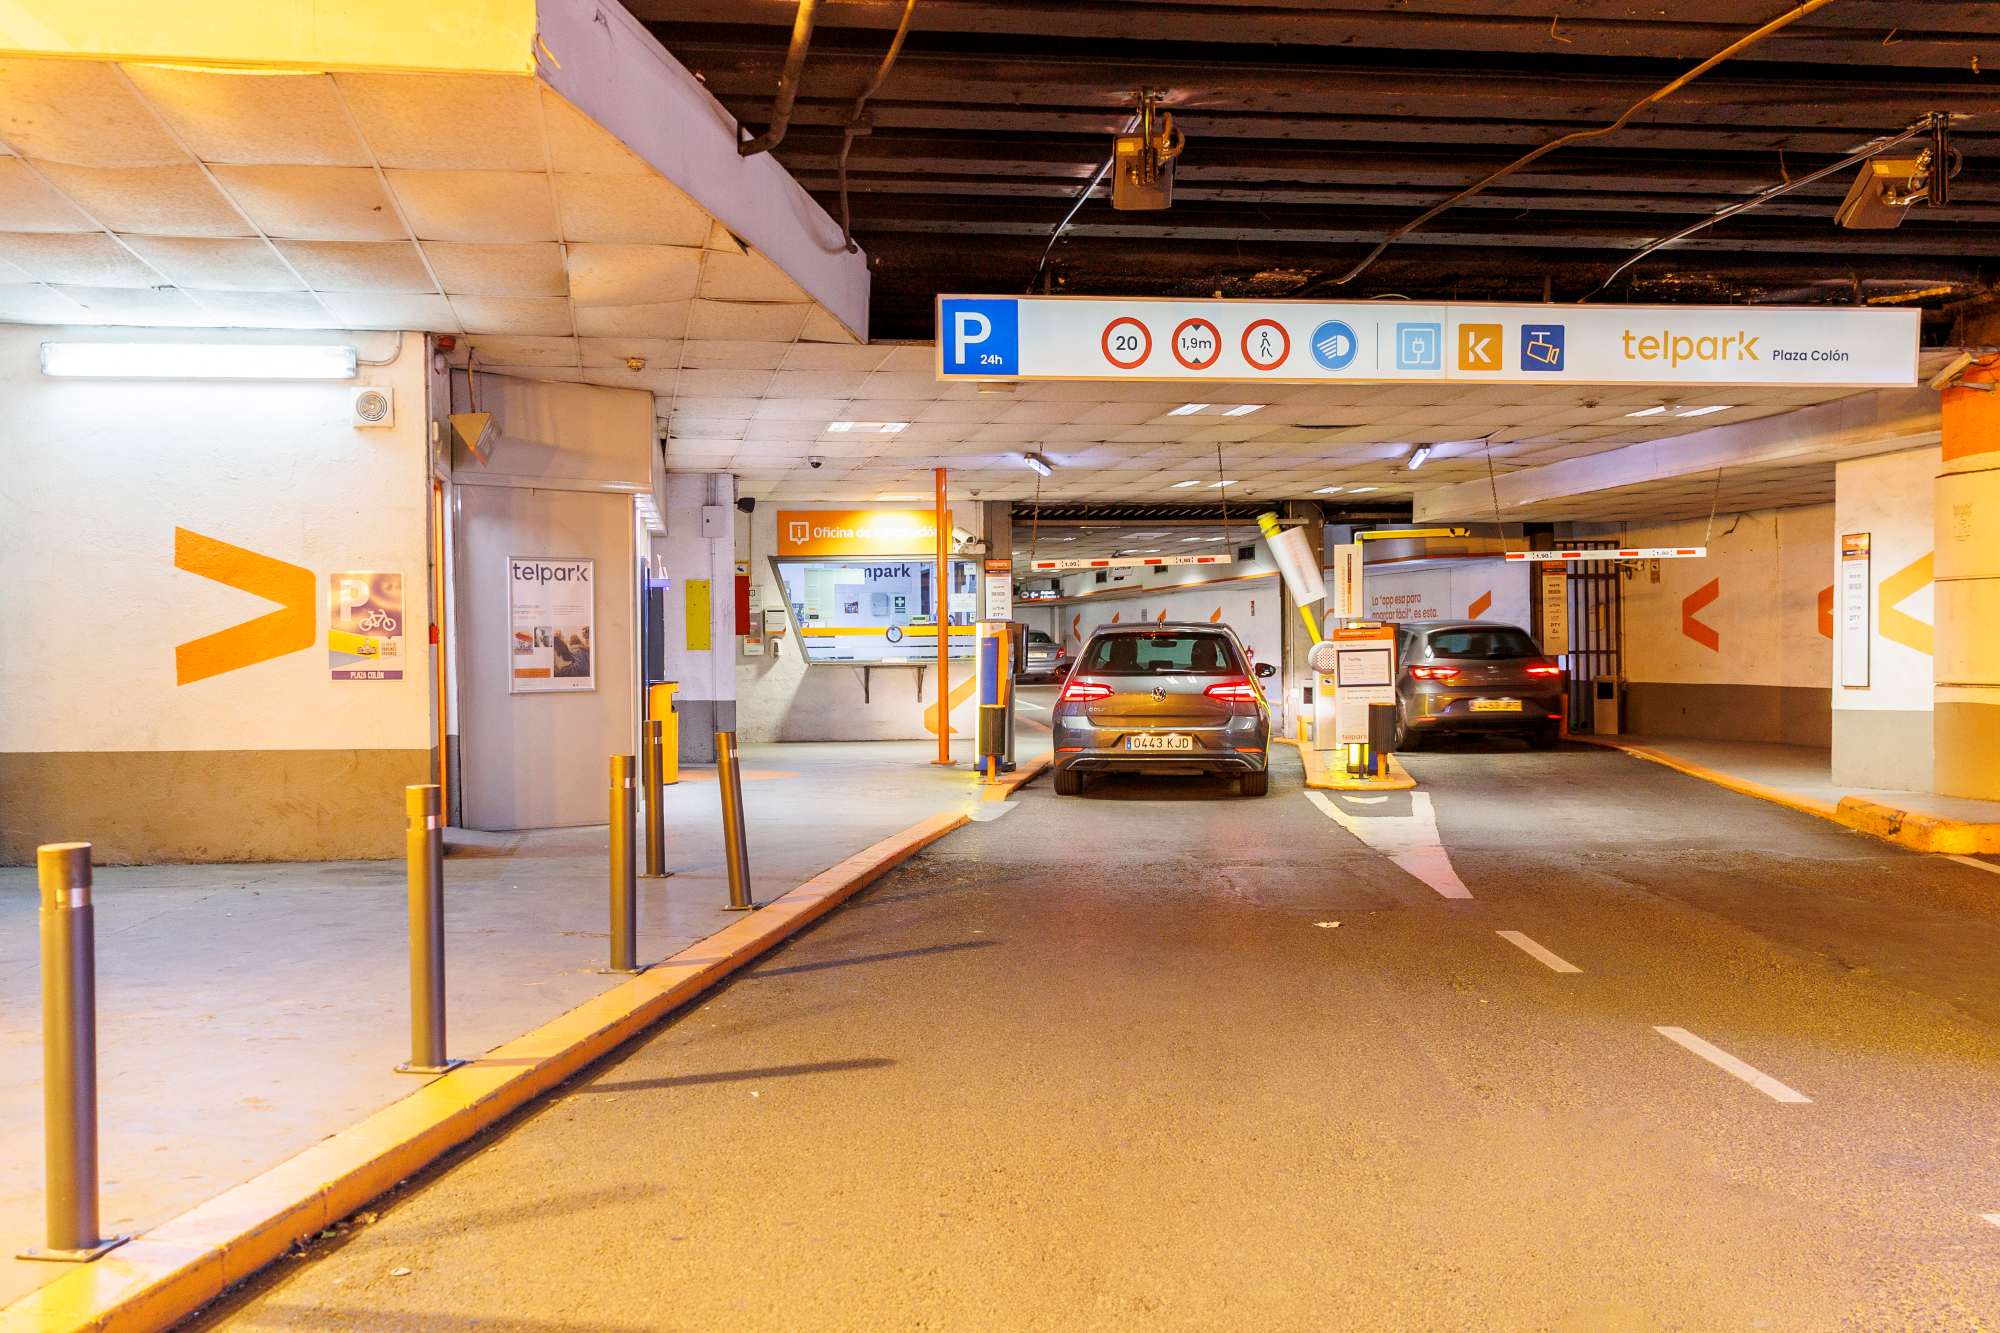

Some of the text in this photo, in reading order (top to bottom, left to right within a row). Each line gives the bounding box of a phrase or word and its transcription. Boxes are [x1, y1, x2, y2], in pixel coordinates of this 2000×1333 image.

[955, 311, 991, 364] P
[1115, 335, 1138, 351] 20
[1181, 337, 1212, 350] 1,9m
[1622, 329, 1760, 368] telpark
[1772, 348, 1849, 361] Plaza Colón
[980, 354, 1003, 365] 24h
[813, 527, 853, 539] Oficina
[512, 563, 589, 585] telpark
[1406, 593, 1421, 607] para
[350, 671, 367, 679] PLAZA
[1134, 738, 1189, 749] 0443 KJD
